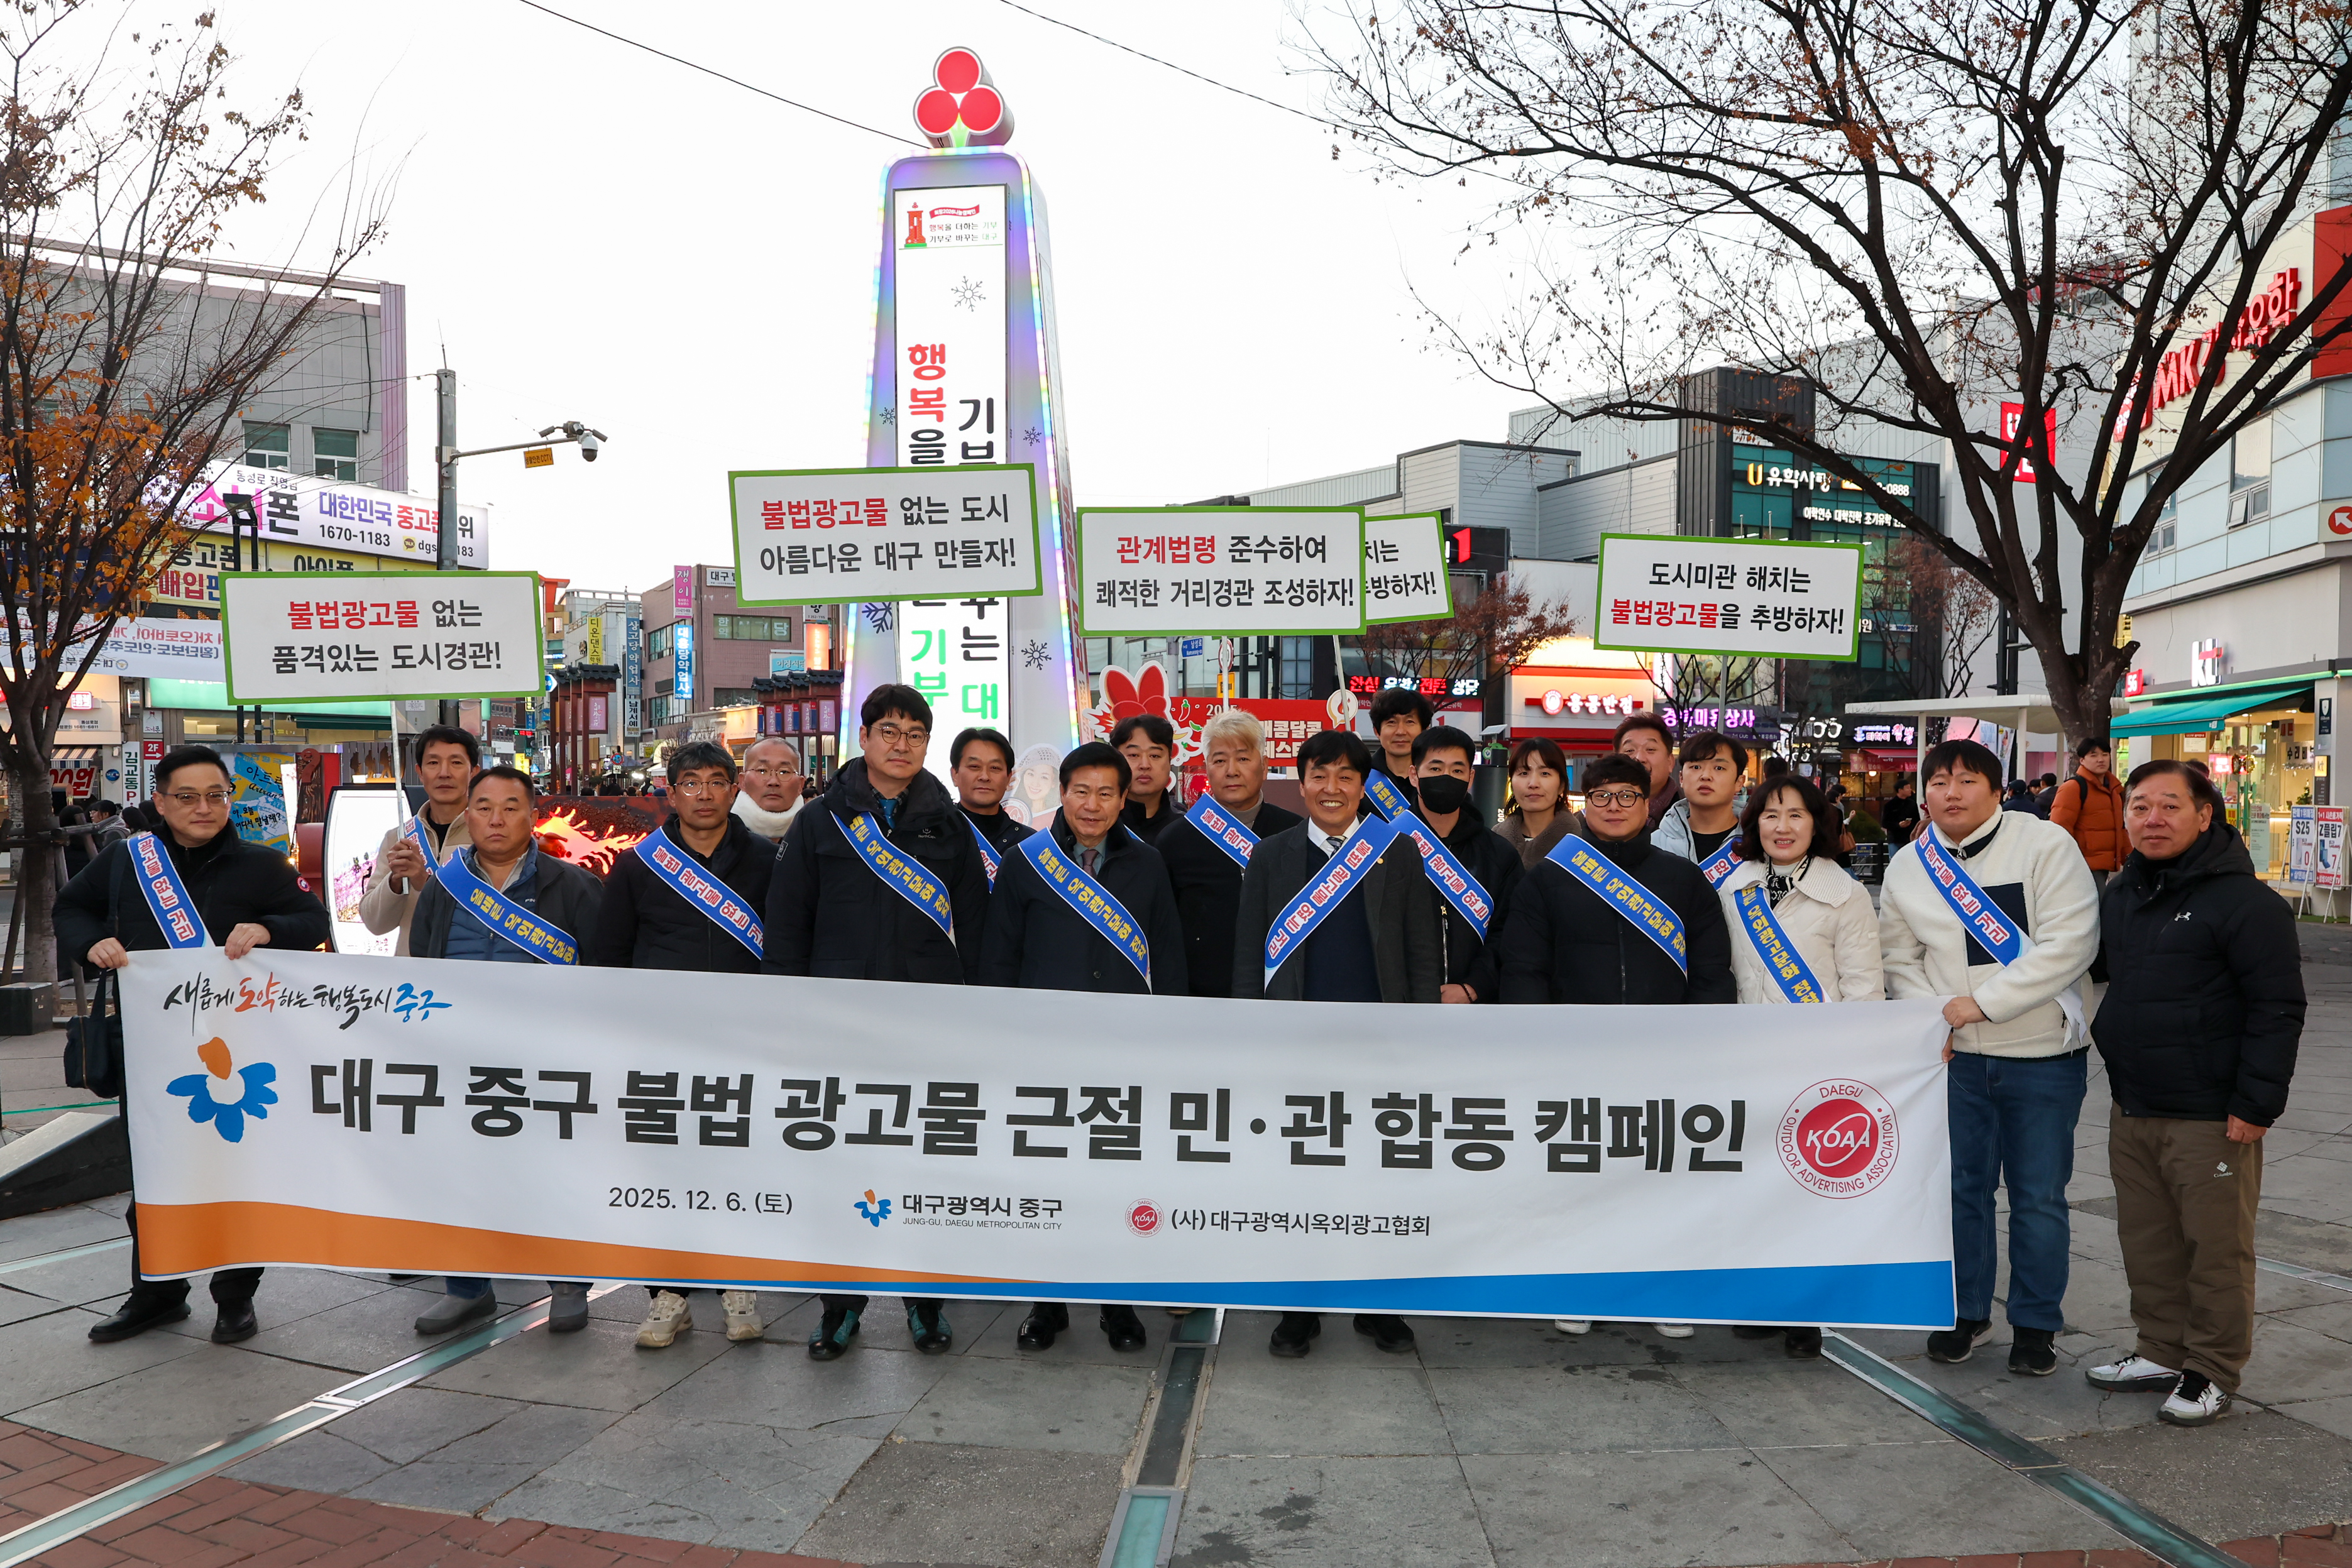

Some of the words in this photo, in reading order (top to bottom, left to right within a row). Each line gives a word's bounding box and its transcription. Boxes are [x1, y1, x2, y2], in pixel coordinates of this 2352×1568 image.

[930, 224, 952, 232] 행복을
[955, 222, 979, 231] 더하는
[982, 221, 997, 229] 기부
[930, 234, 952, 243] 기부로
[955, 234, 979, 242] 바꾸는
[236, 469, 266, 485] 동성로
[319, 491, 392, 527] 대한민국
[761, 498, 888, 530] 불법광고물
[900, 496, 949, 526] 없는
[961, 494, 1009, 522] 도시
[1834, 510, 1862, 524] 대학진학
[1864, 512, 1891, 527] 조기유학
[319, 525, 390, 546] 1670-1183
[1117, 535, 1216, 564] 관계법령
[1228, 535, 1327, 563] 준수하여
[761, 544, 862, 575] 아름다운
[874, 541, 923, 570] 대구
[934, 537, 1016, 569] 만들자!
[711, 571, 728, 581] 대구
[1366, 572, 1436, 600] 방하자!
[1649, 562, 1737, 590] 도시미관
[1746, 564, 1811, 593] 해치는
[1096, 579, 1160, 606] 쾌적한
[1170, 579, 1254, 606] 거리경관
[1263, 578, 1353, 606] 조성하자!
[288, 600, 420, 630] 불법광고물
[432, 600, 483, 627] 없는
[1611, 598, 1741, 629] 불법광고물을
[1750, 605, 1844, 635] 추방하자!
[272, 644, 379, 674] 품격있는
[392, 641, 501, 671] 도시경관!
[1191, 639, 1202, 649] 남성로
[677, 627, 690, 693] 대흥당약업사
[2191, 637, 2223, 688] kt
[1452, 679, 1479, 696] 상담
[1206, 703, 1238, 716] 205
[1568, 693, 1633, 714] 홍콩반점
[2317, 760, 2324, 772] kt
[1371, 780, 1401, 808] 올바른
[236, 819, 253, 831] 어디서
[255, 813, 281, 827] 만날래?
[1199, 808, 1226, 834] 불법
[2296, 821, 2310, 835] S25
[2319, 823, 2341, 838] Z플립7
[1345, 839, 1373, 870] 불법
[2305, 851, 2309, 865] 0
[2332, 855, 2336, 869] 7
[867, 839, 936, 904] 옥외광고문화
[1310, 864, 1351, 907] 광고물
[138, 838, 163, 878] 광고물
[151, 877, 179, 908] 없는
[165, 911, 197, 942] 거리
[652, 845, 681, 875] 불법
[678, 869, 722, 906] 광고물
[720, 899, 749, 931] 없는
[1429, 854, 1466, 894] 광고물
[1463, 889, 1490, 919] 없는
[1571, 850, 1612, 884] 올바른
[1605, 879, 1675, 940] 옥외광고문화
[1925, 845, 1956, 887] 광고물
[1951, 882, 1982, 916] 없는
[1975, 911, 2011, 947] 거리
[1038, 847, 1070, 882] 올바른
[1067, 877, 1133, 942] 옥외광고문화
[1129, 935, 1147, 961] 정착
[1284, 902, 1316, 933] 없는
[470, 887, 505, 916] 올바른
[504, 914, 578, 964] 옥외광고문화
[1267, 928, 1290, 960] 거리
[1748, 904, 1801, 981] 옥외광고문화
[163, 972, 234, 1036] 새롭게
[234, 972, 314, 1014] 도약하는
[314, 984, 392, 1031] 행복도시
[392, 982, 453, 1023] 중구
[1820, 1085, 1863, 1098] DAEGU
[310, 1058, 445, 1134] 대구
[464, 1065, 598, 1140] 중구
[617, 1070, 754, 1148] 불법
[774, 1077, 986, 1156] 광고물
[1006, 1085, 1143, 1161] 근절
[1170, 1087, 1351, 1166] 민·관
[1371, 1092, 1514, 1171] 합동
[1534, 1097, 1745, 1173] 캠페인
[1806, 1129, 1871, 1148] KOAA
[1781, 1117, 1801, 1170] OUTDOOR
[1797, 1168, 1864, 1193] ADVERTISING
[1866, 1115, 1894, 1183] ASSOCIATION
[608, 1187, 676, 1210] 2025.
[684, 1190, 717, 1210] 12.
[725, 1192, 747, 1212] 6.
[754, 1192, 793, 1215] (토)
[903, 1195, 1011, 1216] 대구광역시
[1019, 1198, 1062, 1218] 중구
[903, 1218, 942, 1227] JUNG-GU,
[977, 1220, 1040, 1229] METROPOLITAN
[1131, 1227, 1152, 1236] ADVERTISING
